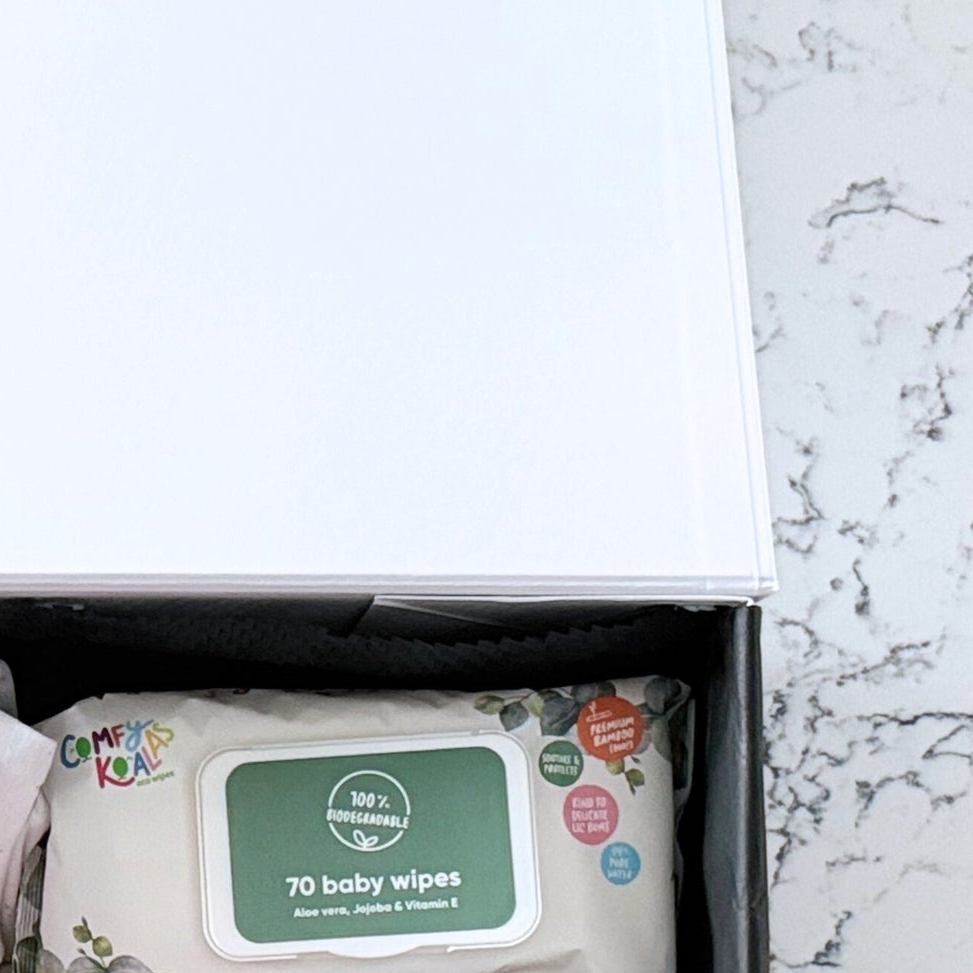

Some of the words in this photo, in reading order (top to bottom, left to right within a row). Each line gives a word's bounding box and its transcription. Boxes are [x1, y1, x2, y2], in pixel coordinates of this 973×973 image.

[60, 719, 154, 768] COMFY
[593, 728, 635, 748] BAMBOO
[95, 722, 175, 789] KOALAS
[350, 790, 391, 809] 100%
[326, 808, 410, 829] BIODEGRADABLE
[285, 875, 316, 897] 70
[321, 872, 384, 896] baby
[390, 868, 462, 893] wipes
[293, 907, 319, 918] Aloe
[321, 906, 350, 916] vera,
[352, 903, 392, 915] Jojoba
[394, 903, 403, 912] &
[405, 899, 449, 910] Vitamin
[451, 897, 459, 908] E
